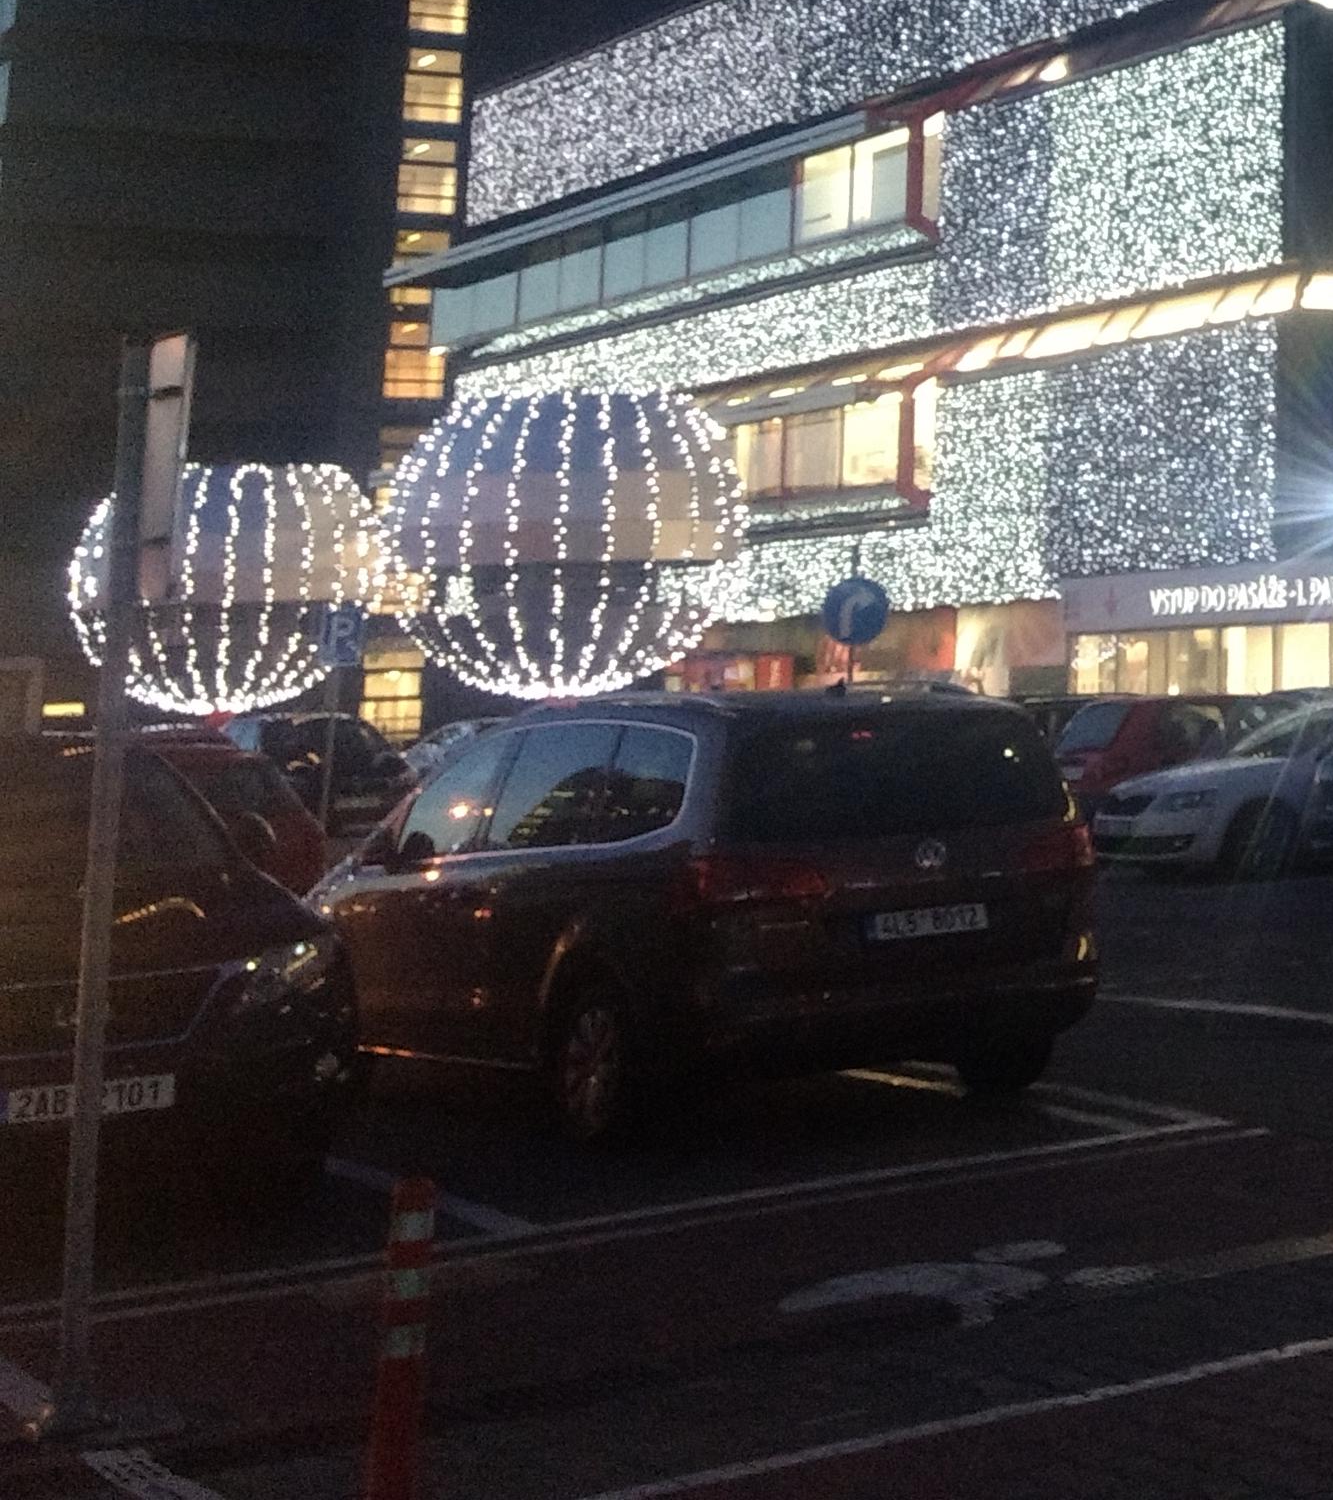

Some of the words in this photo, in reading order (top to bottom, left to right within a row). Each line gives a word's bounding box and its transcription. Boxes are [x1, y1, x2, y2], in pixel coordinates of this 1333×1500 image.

[1149, 586, 1200, 616] VSTUP
[1200, 585, 1226, 613] DO
[330, 615, 355, 654] P
